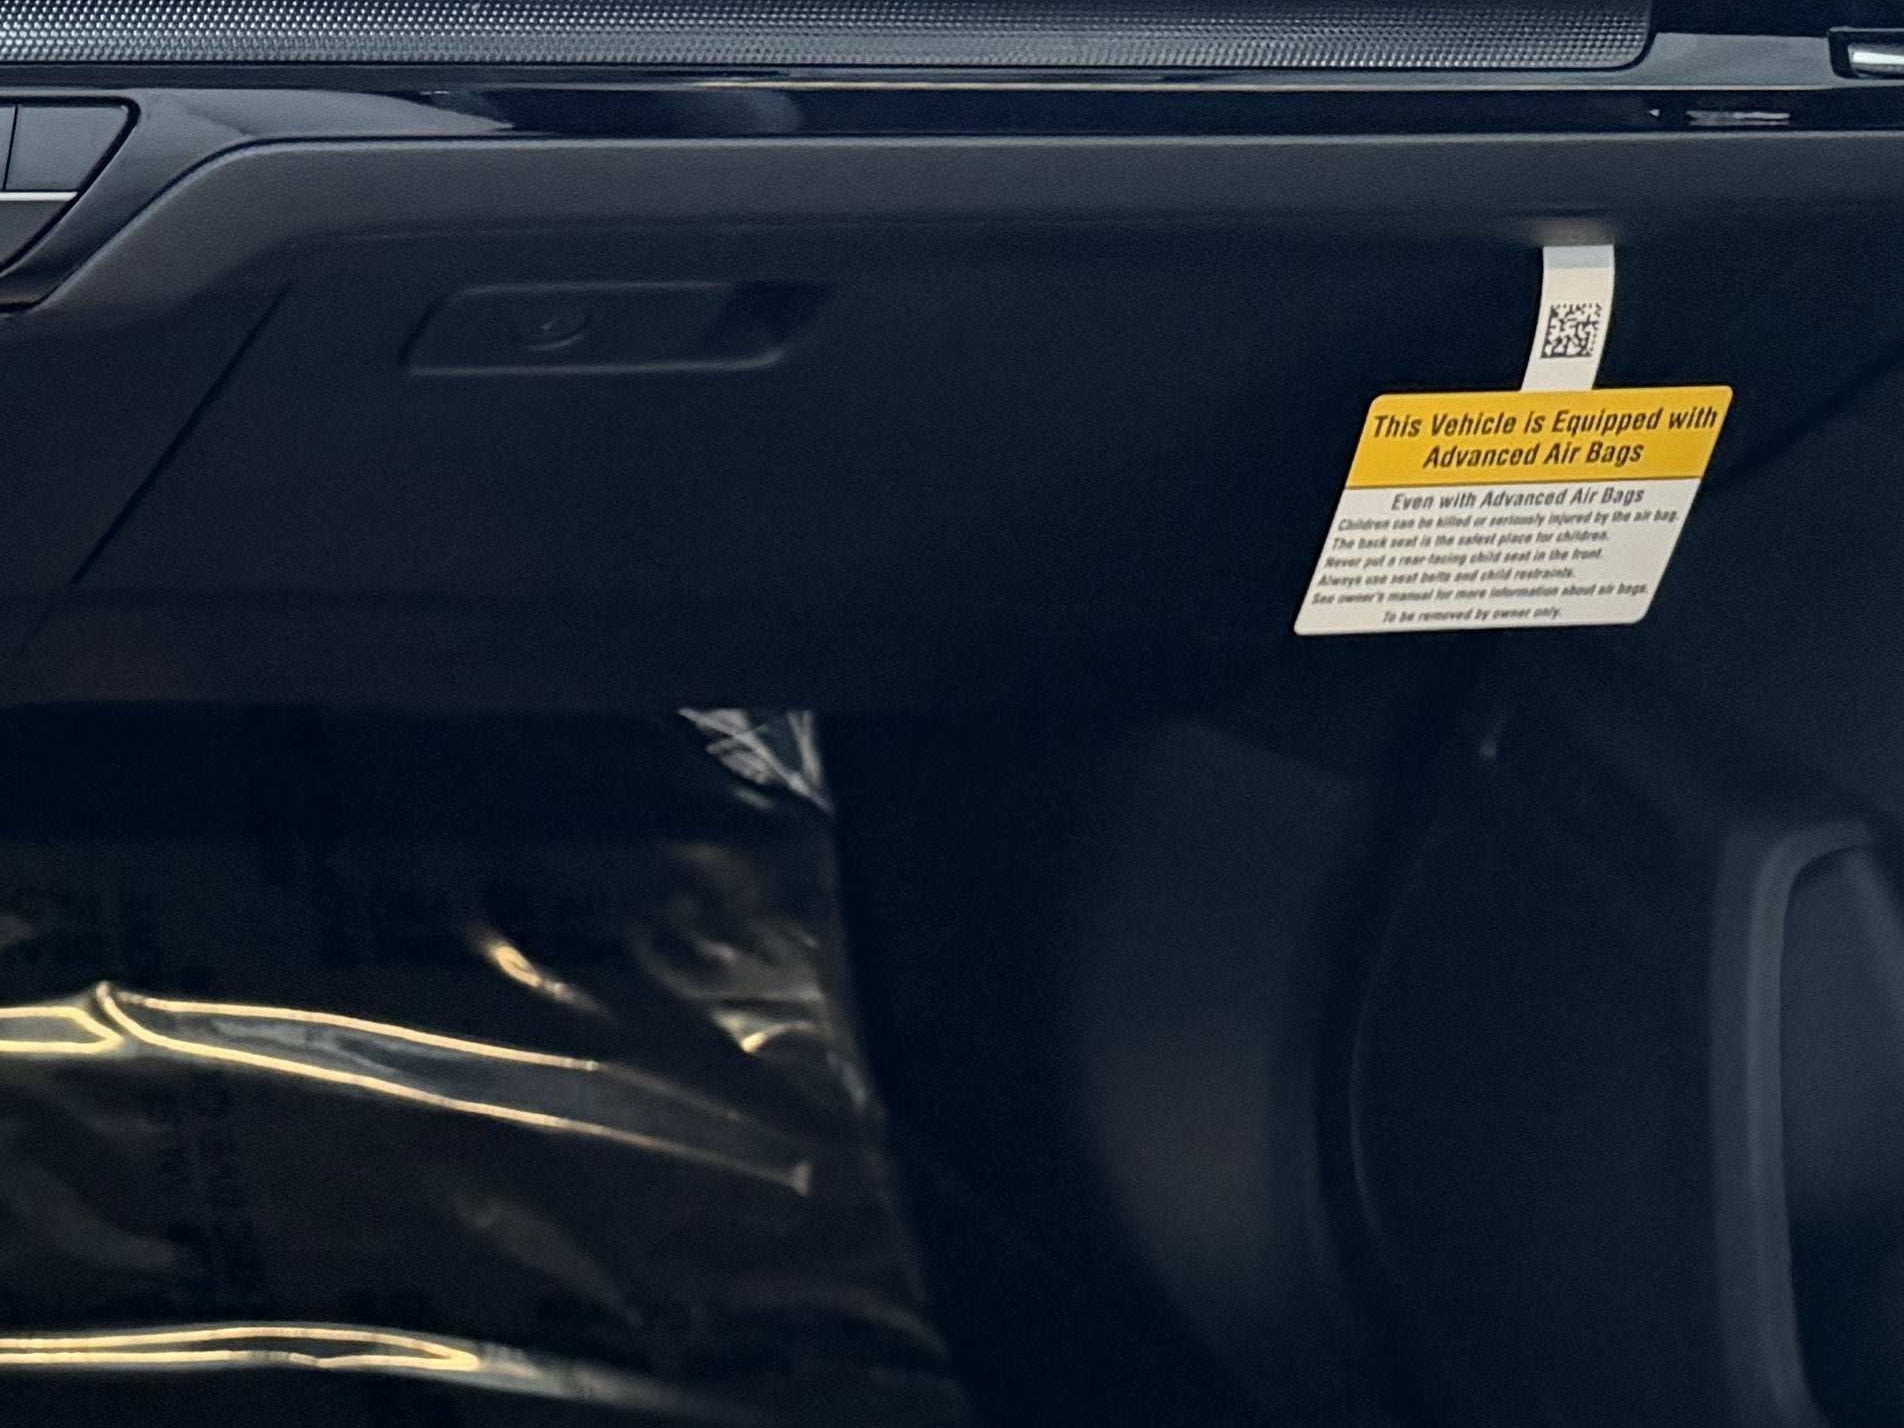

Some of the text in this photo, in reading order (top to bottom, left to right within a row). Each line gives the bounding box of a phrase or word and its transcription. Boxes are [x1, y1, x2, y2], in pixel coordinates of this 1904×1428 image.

[1373, 405, 1719, 439] This Vehicle is Equipped with
[1421, 441, 1645, 469] Advanced Air Bags
[1391, 486, 1645, 511] Even with Advanced Air Bags
[1337, 518, 1390, 532] Children
[1391, 519, 1415, 530] can
[1416, 516, 1433, 529] be
[1435, 515, 1473, 528] killed
[1547, 511, 1593, 526] injured
[1593, 511, 1611, 525] by
[1611, 510, 1631, 522] the
[1331, 537, 1355, 550] The
[1357, 536, 1388, 549] back
[1391, 535, 1418, 548] seat
[1435, 534, 1455, 546] the
[1497, 532, 1533, 547] place
[1323, 556, 1363, 568] Never
[1363, 555, 1386, 569] put
[1469, 551, 1502, 563] child
[1503, 550, 1531, 562] seat
[1548, 549, 1569, 560] the
[1316, 575, 1363, 588] Always
[1391, 573, 1419, 584] seat
[1453, 570, 1479, 582] and
[1479, 569, 1513, 581] child
[1310, 592, 1335, 605] See
[1386, 590, 1435, 602] manual
[1454, 589, 1486, 600] more
[1488, 586, 1560, 599] information
[1561, 584, 1597, 596] about
[1382, 610, 1398, 623] To
[1398, 609, 1416, 622] be
[1418, 609, 1474, 622] removed
[1476, 608, 1490, 621] by
[1492, 608, 1531, 619] owner
